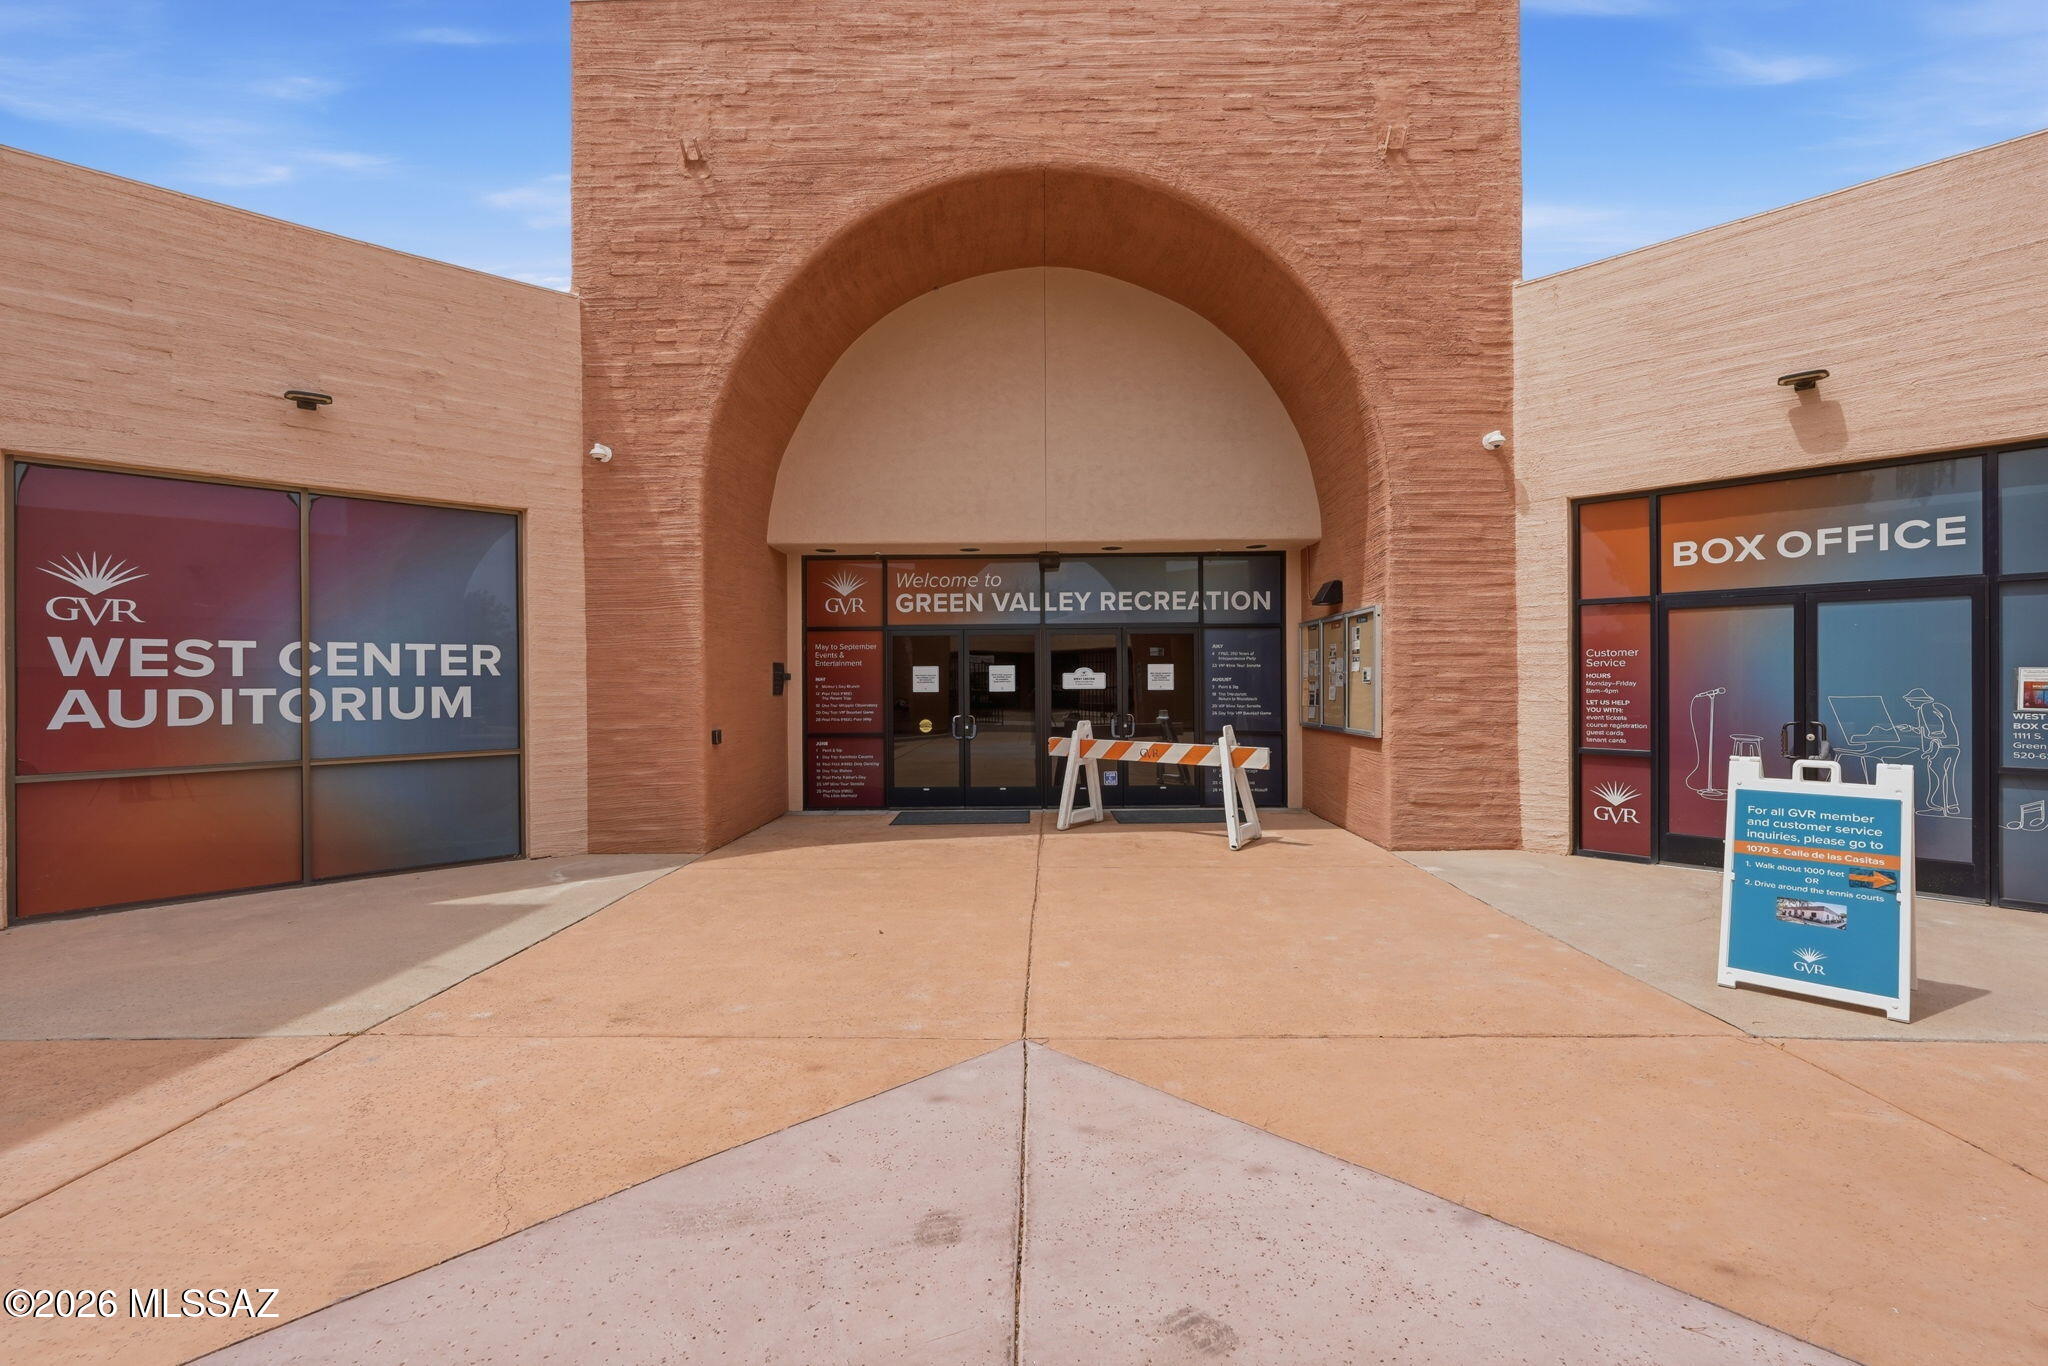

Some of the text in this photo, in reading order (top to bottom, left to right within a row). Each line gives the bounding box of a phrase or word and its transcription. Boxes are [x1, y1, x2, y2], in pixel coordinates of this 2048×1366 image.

[1673, 515, 1967, 567] BOX OFFICE
[896, 572, 1002, 589] Welcome to
[825, 598, 866, 615] GVR
[895, 590, 1272, 613] GREEN VALLEY RECREATION
[46, 597, 145, 626] GVR
[47, 636, 501, 677] WEST CENTER
[1586, 649, 1640, 657] Customer
[1586, 658, 1626, 667] Service
[46, 685, 472, 730] AUDITORIUM
[1140, 748, 1159, 758] GVR
[1594, 806, 1640, 824] GVR
[1748, 806, 1875, 824] For all GVR member
[1747, 817, 1882, 837] and customer service
[1747, 829, 1883, 850] inquiries, please go to
[1746, 845, 1770, 854] 1070
[1784, 848, 1809, 857] Calle
[1812, 850, 1825, 859] de
[1827, 852, 1842, 861] las
[1844, 854, 1885, 866] Casitas
[1755, 861, 1774, 870] Walk
[1777, 863, 1801, 873] about
[1803, 867, 1825, 876] 1000
[1827, 869, 1844, 878] feet
[1755, 880, 1776, 889] Drive
[1778, 883, 1808, 892] around
[1810, 886, 1824, 894] the
[1826, 889, 1854, 898] tennis
[1856, 893, 1885, 902] courts
[1794, 962, 1826, 975] GVR
